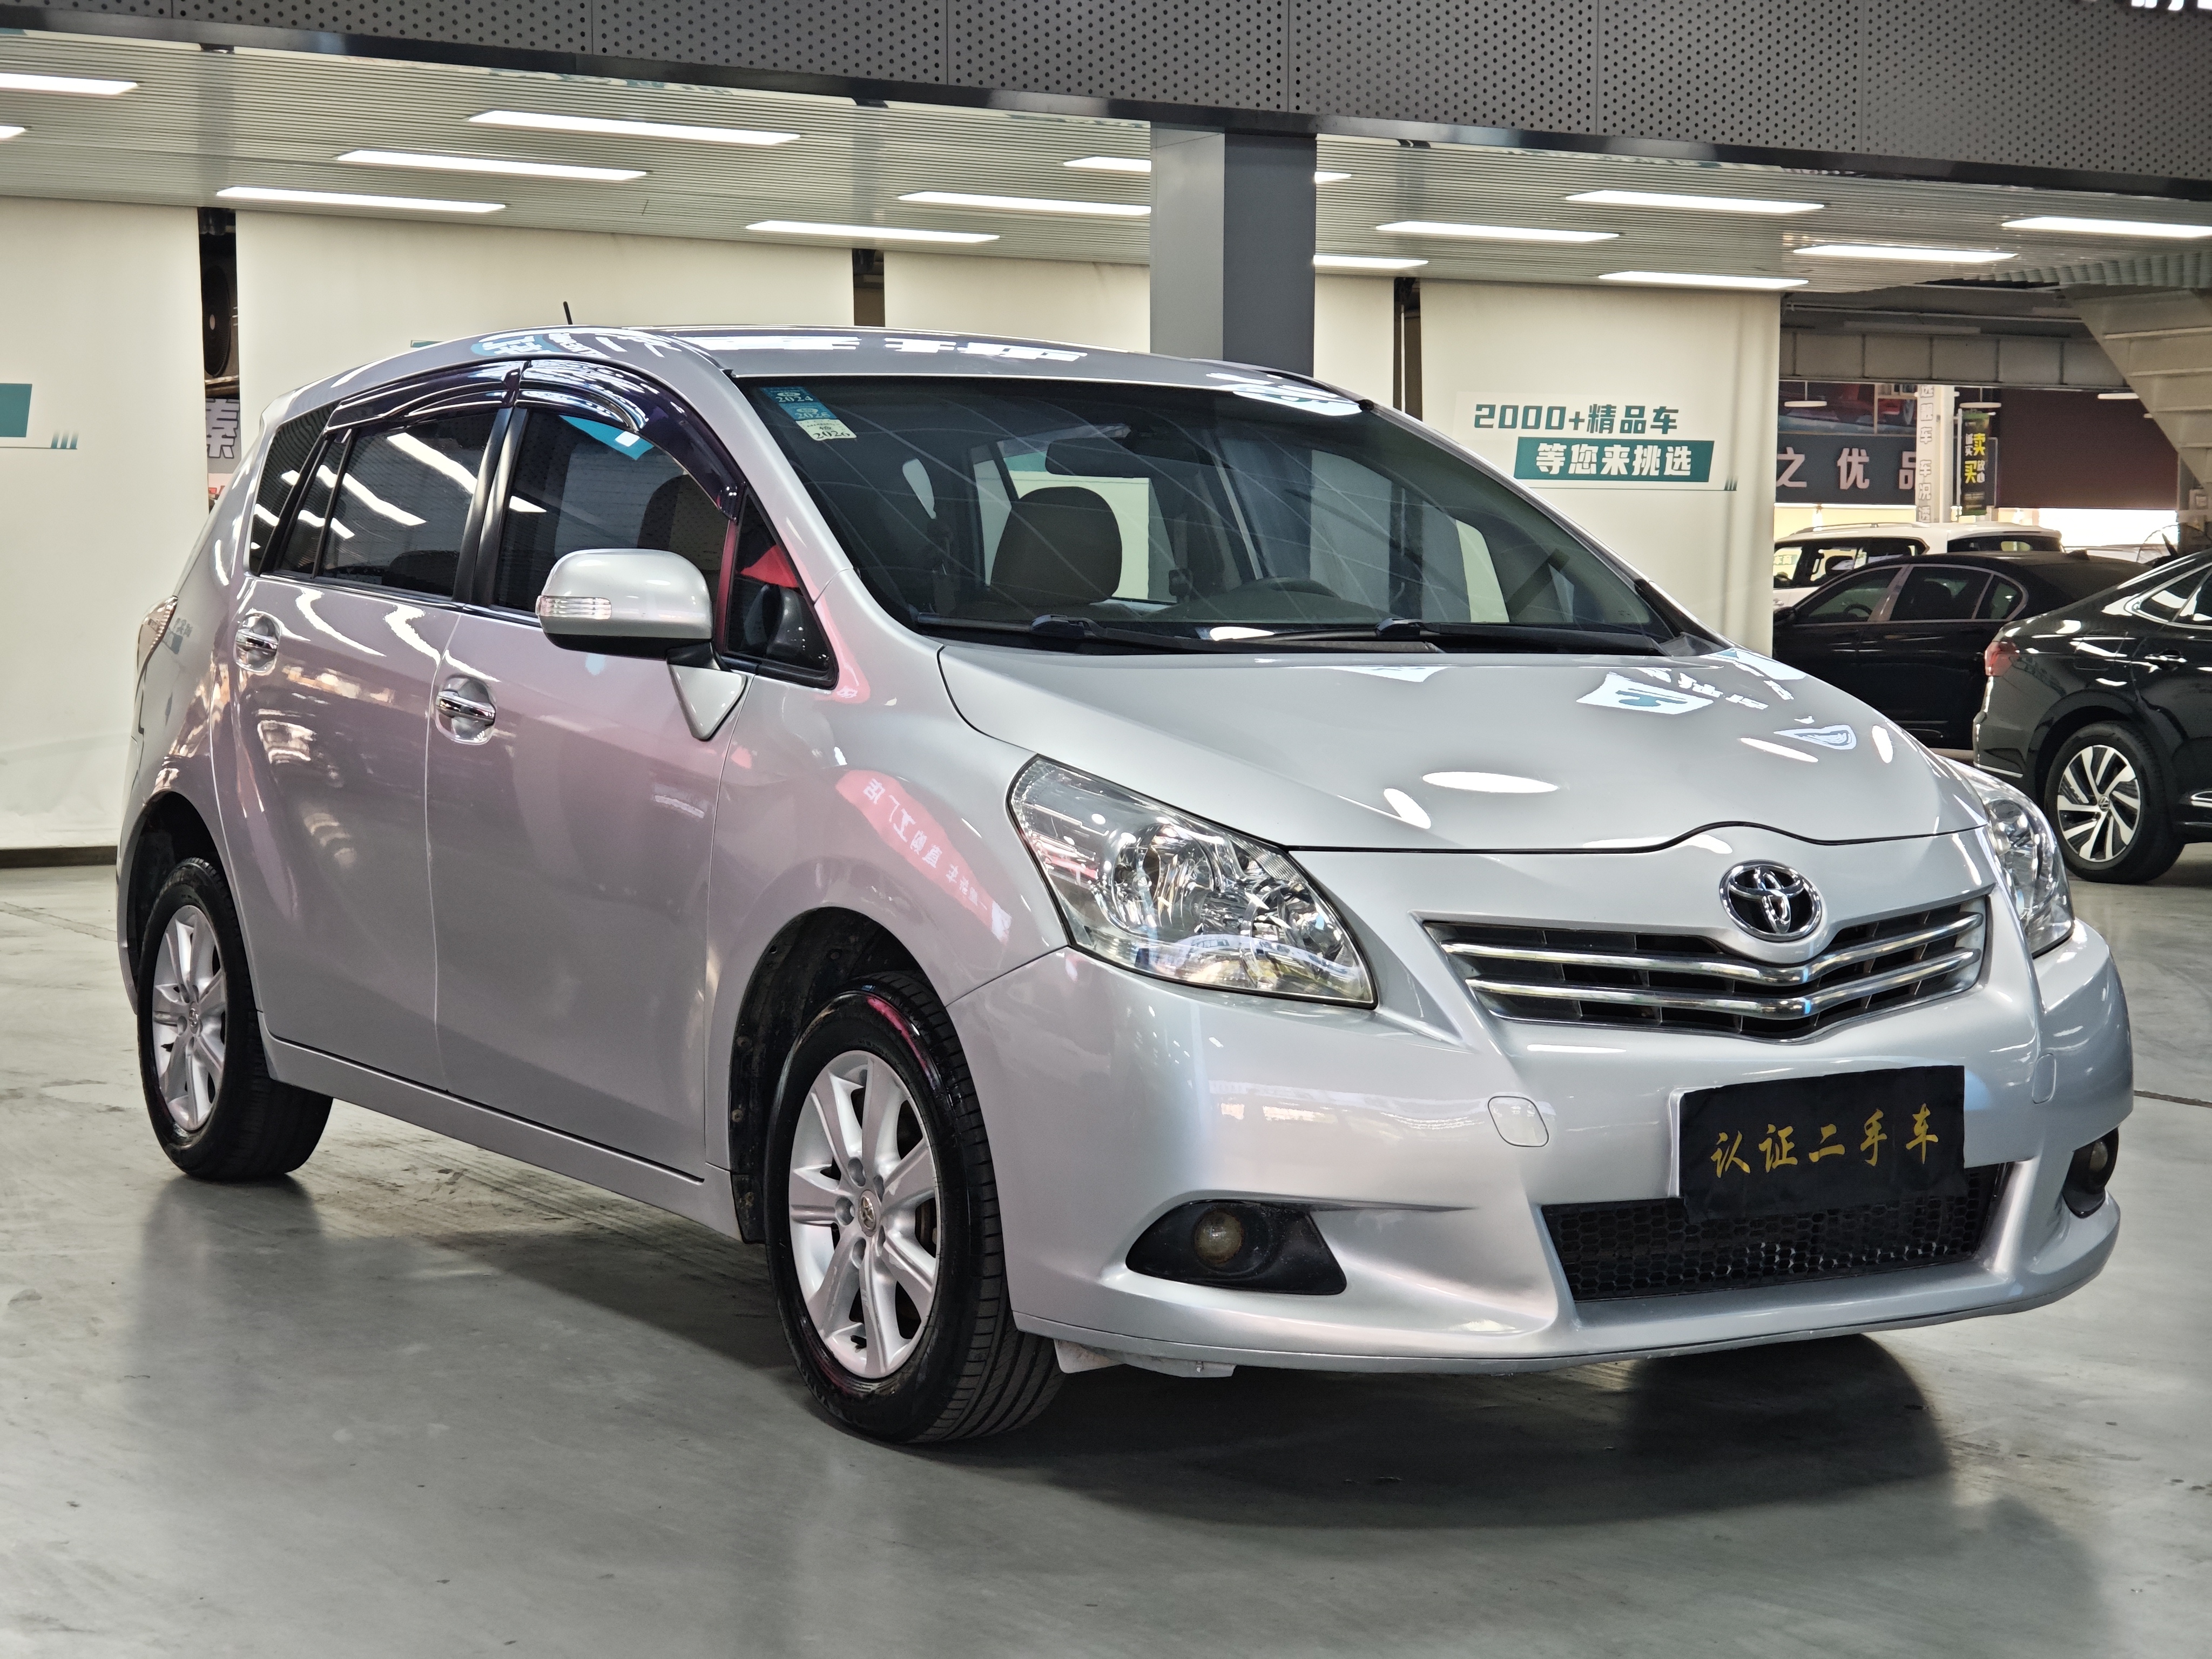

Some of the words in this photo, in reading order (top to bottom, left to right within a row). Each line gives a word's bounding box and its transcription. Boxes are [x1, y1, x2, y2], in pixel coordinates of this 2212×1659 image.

[1474, 403, 1680, 434] 2000+精品车
[812, 430, 851, 440] 2026
[1536, 442, 1692, 476] 等您来挑选
[1710, 1103, 1939, 1178] 认证二手车
